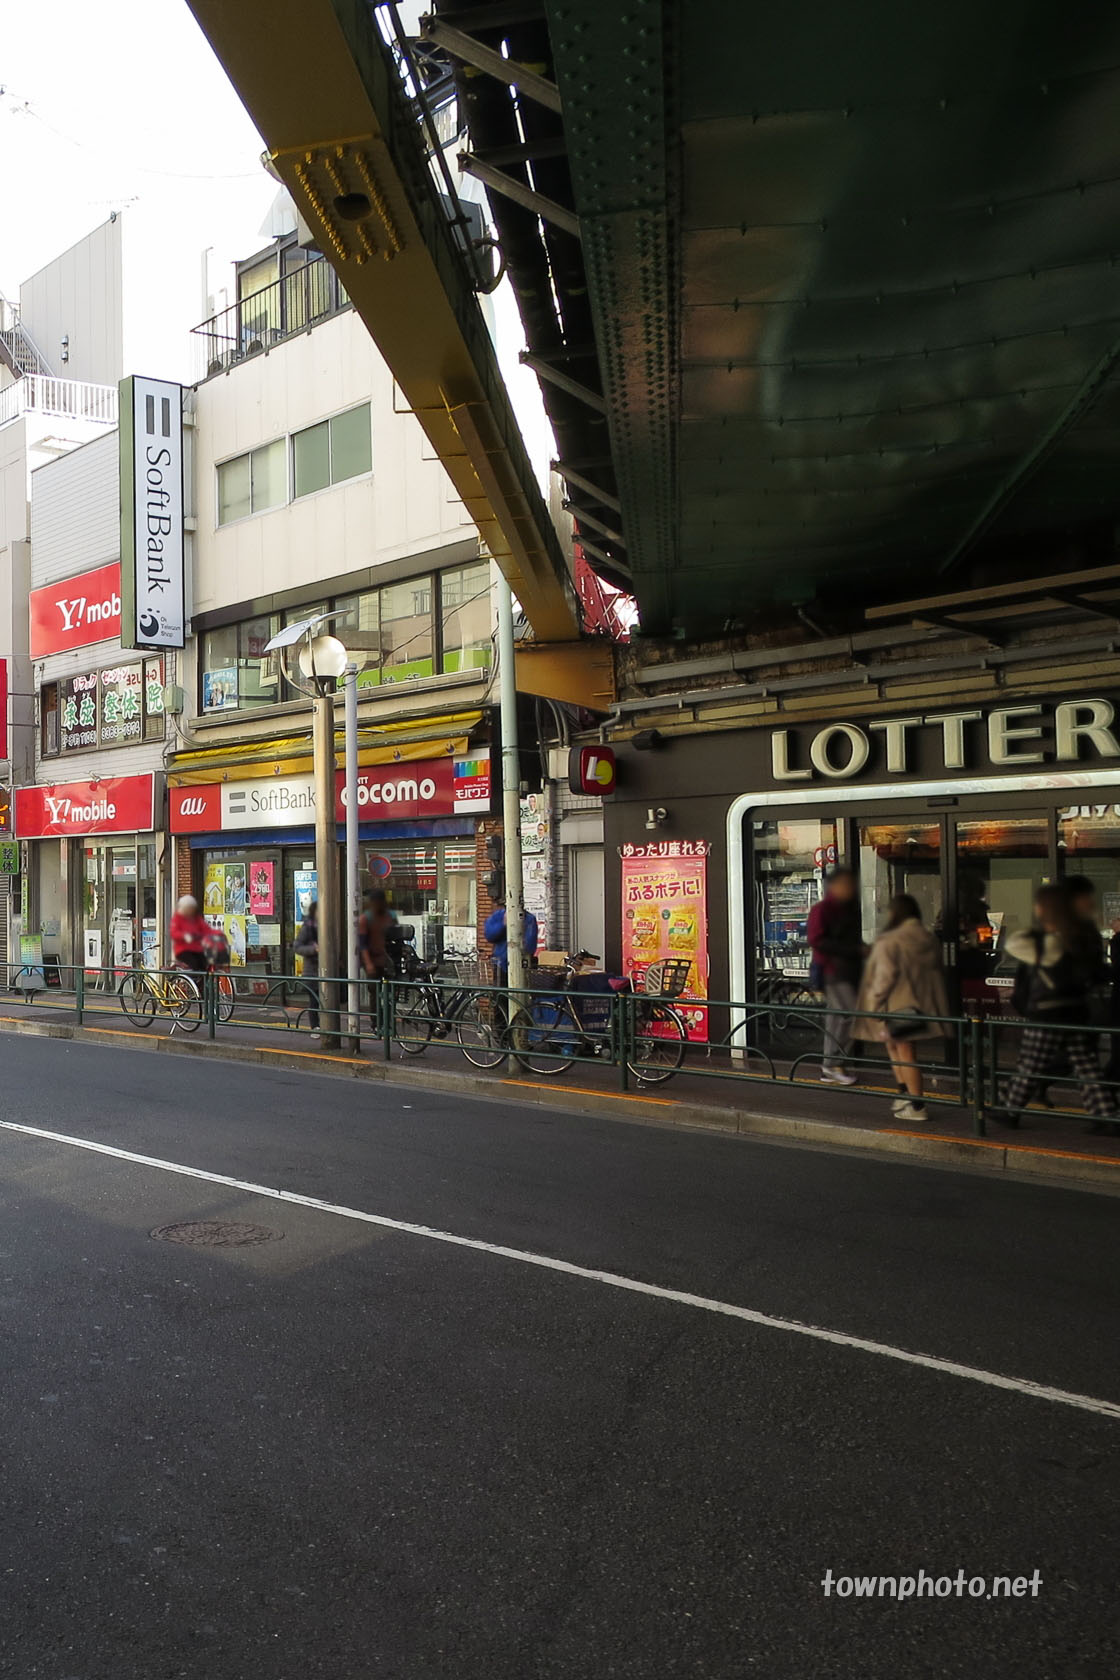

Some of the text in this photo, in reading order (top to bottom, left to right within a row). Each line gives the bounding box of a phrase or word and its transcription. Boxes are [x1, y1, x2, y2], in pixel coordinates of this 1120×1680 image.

[146, 445, 172, 593] SoftBank
[45, 798, 116, 824] Y!mobile
[180, 797, 207, 815] au
[251, 786, 316, 812] SoftBank
[2, 848, 13, 871] 整体
[623, 841, 706, 857] ゆったり座れる
